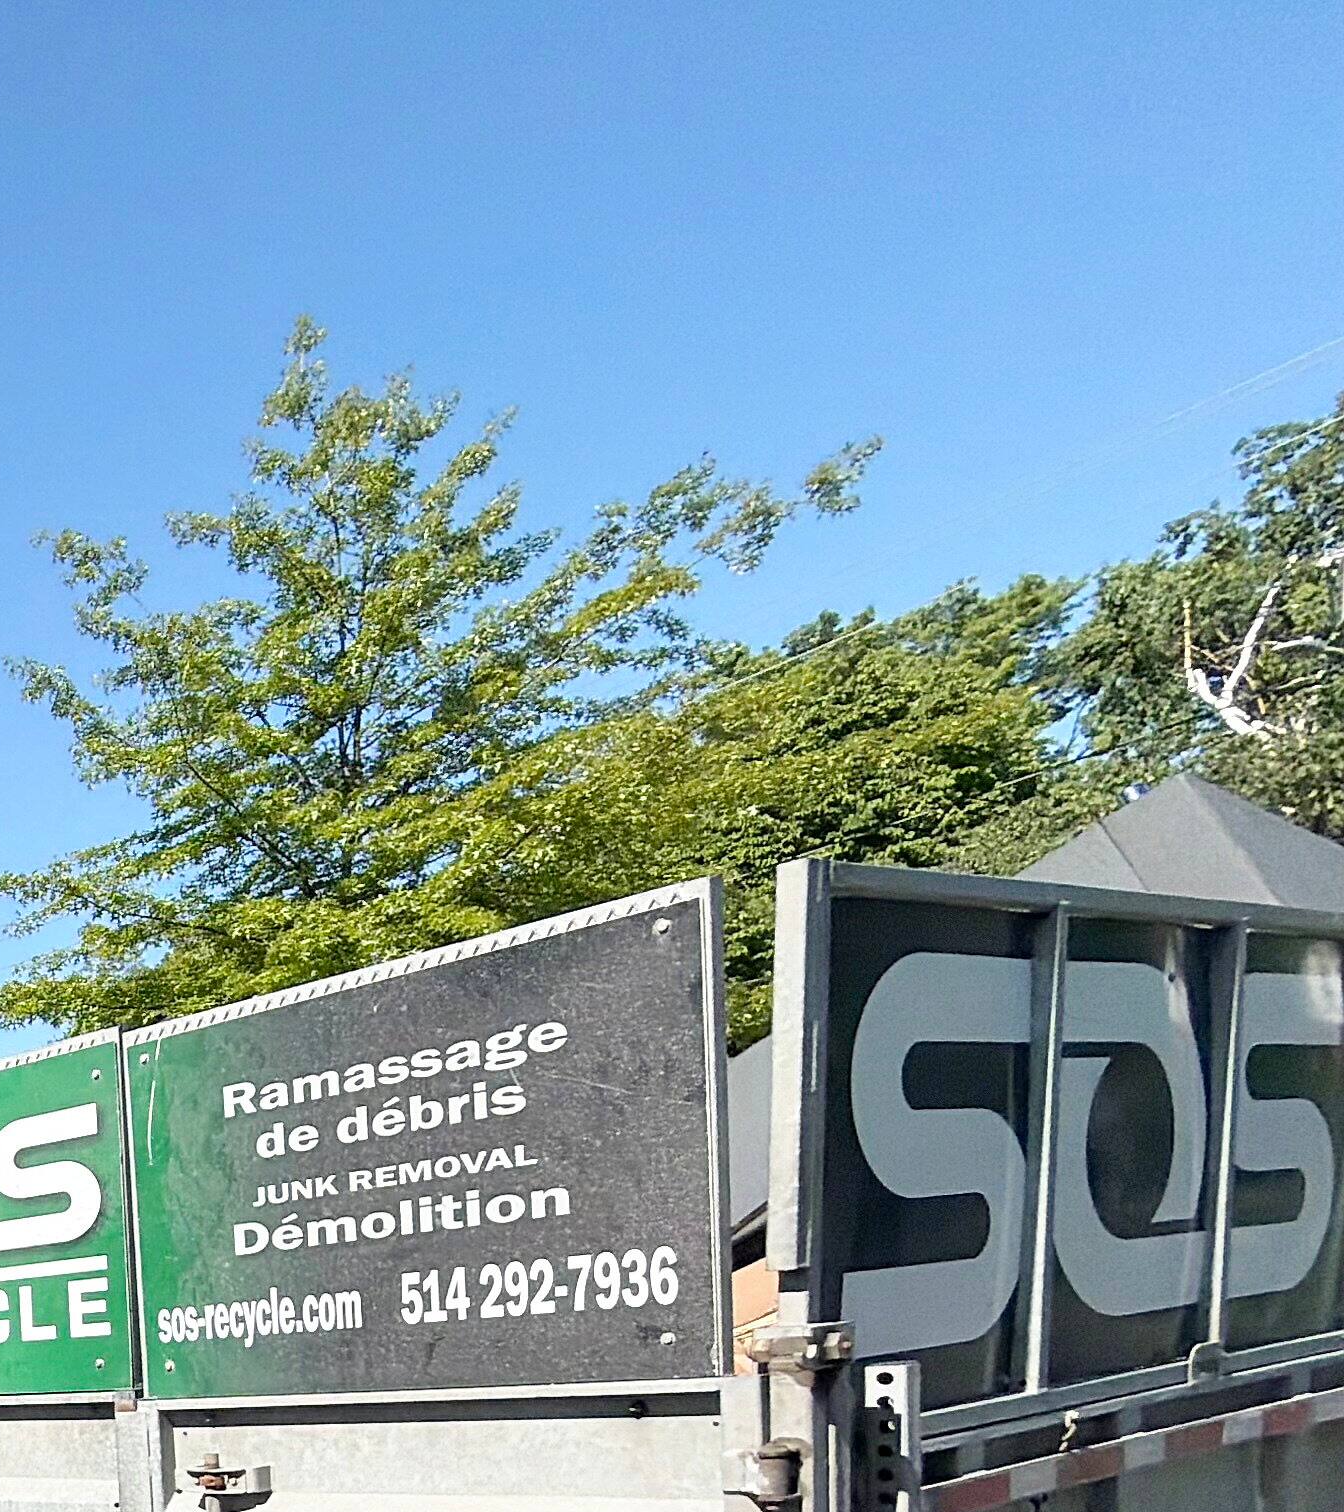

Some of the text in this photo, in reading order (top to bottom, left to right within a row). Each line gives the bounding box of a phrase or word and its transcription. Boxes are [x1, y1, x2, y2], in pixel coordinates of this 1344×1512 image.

[222, 1019, 568, 1119] Ramassage
[255, 1080, 528, 1159] de débris
[841, 951, 1343, 1360] SOS
[232, 1185, 572, 1256] Démolition
[252, 1144, 539, 1208] JUNK REMOVAL
[157, 1245, 679, 1348] sos-recycle.com 514 292-7936
